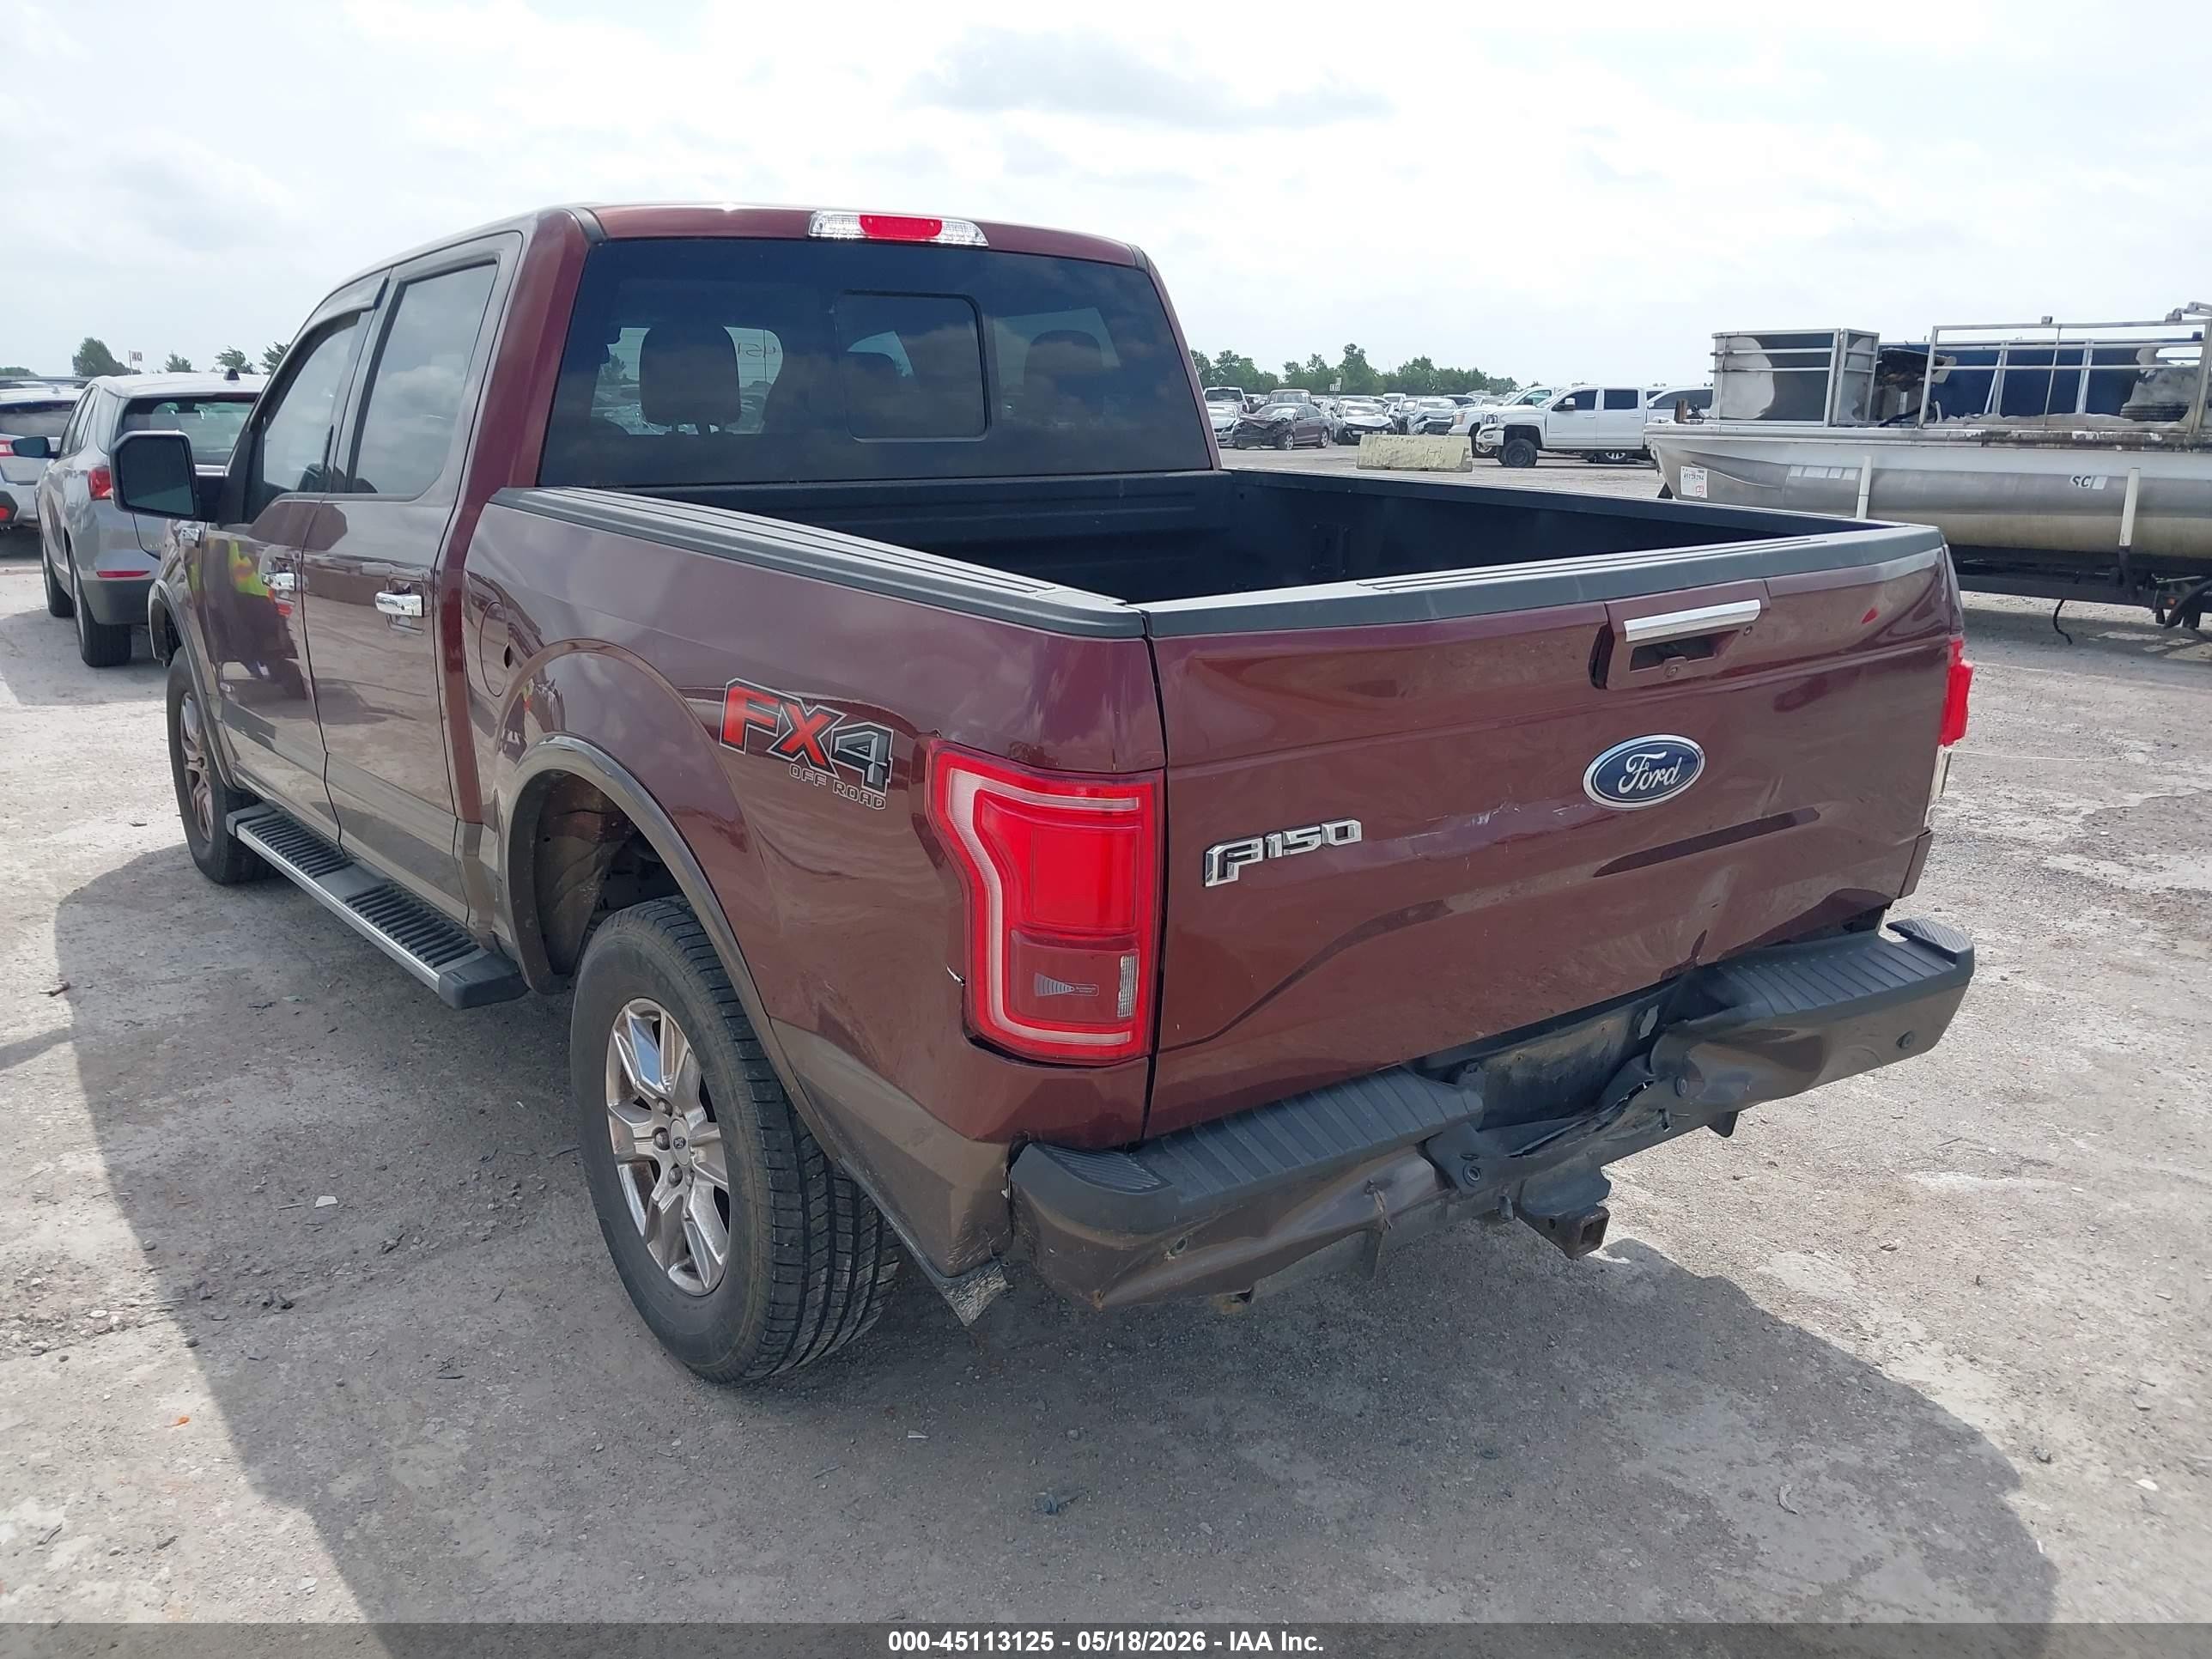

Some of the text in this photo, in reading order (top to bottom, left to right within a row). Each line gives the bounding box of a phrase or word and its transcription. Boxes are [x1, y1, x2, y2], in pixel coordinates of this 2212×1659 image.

[720, 678, 894, 797] FX4
[790, 763, 886, 810] OFF ROAD
[1618, 750, 1682, 793] Ford
